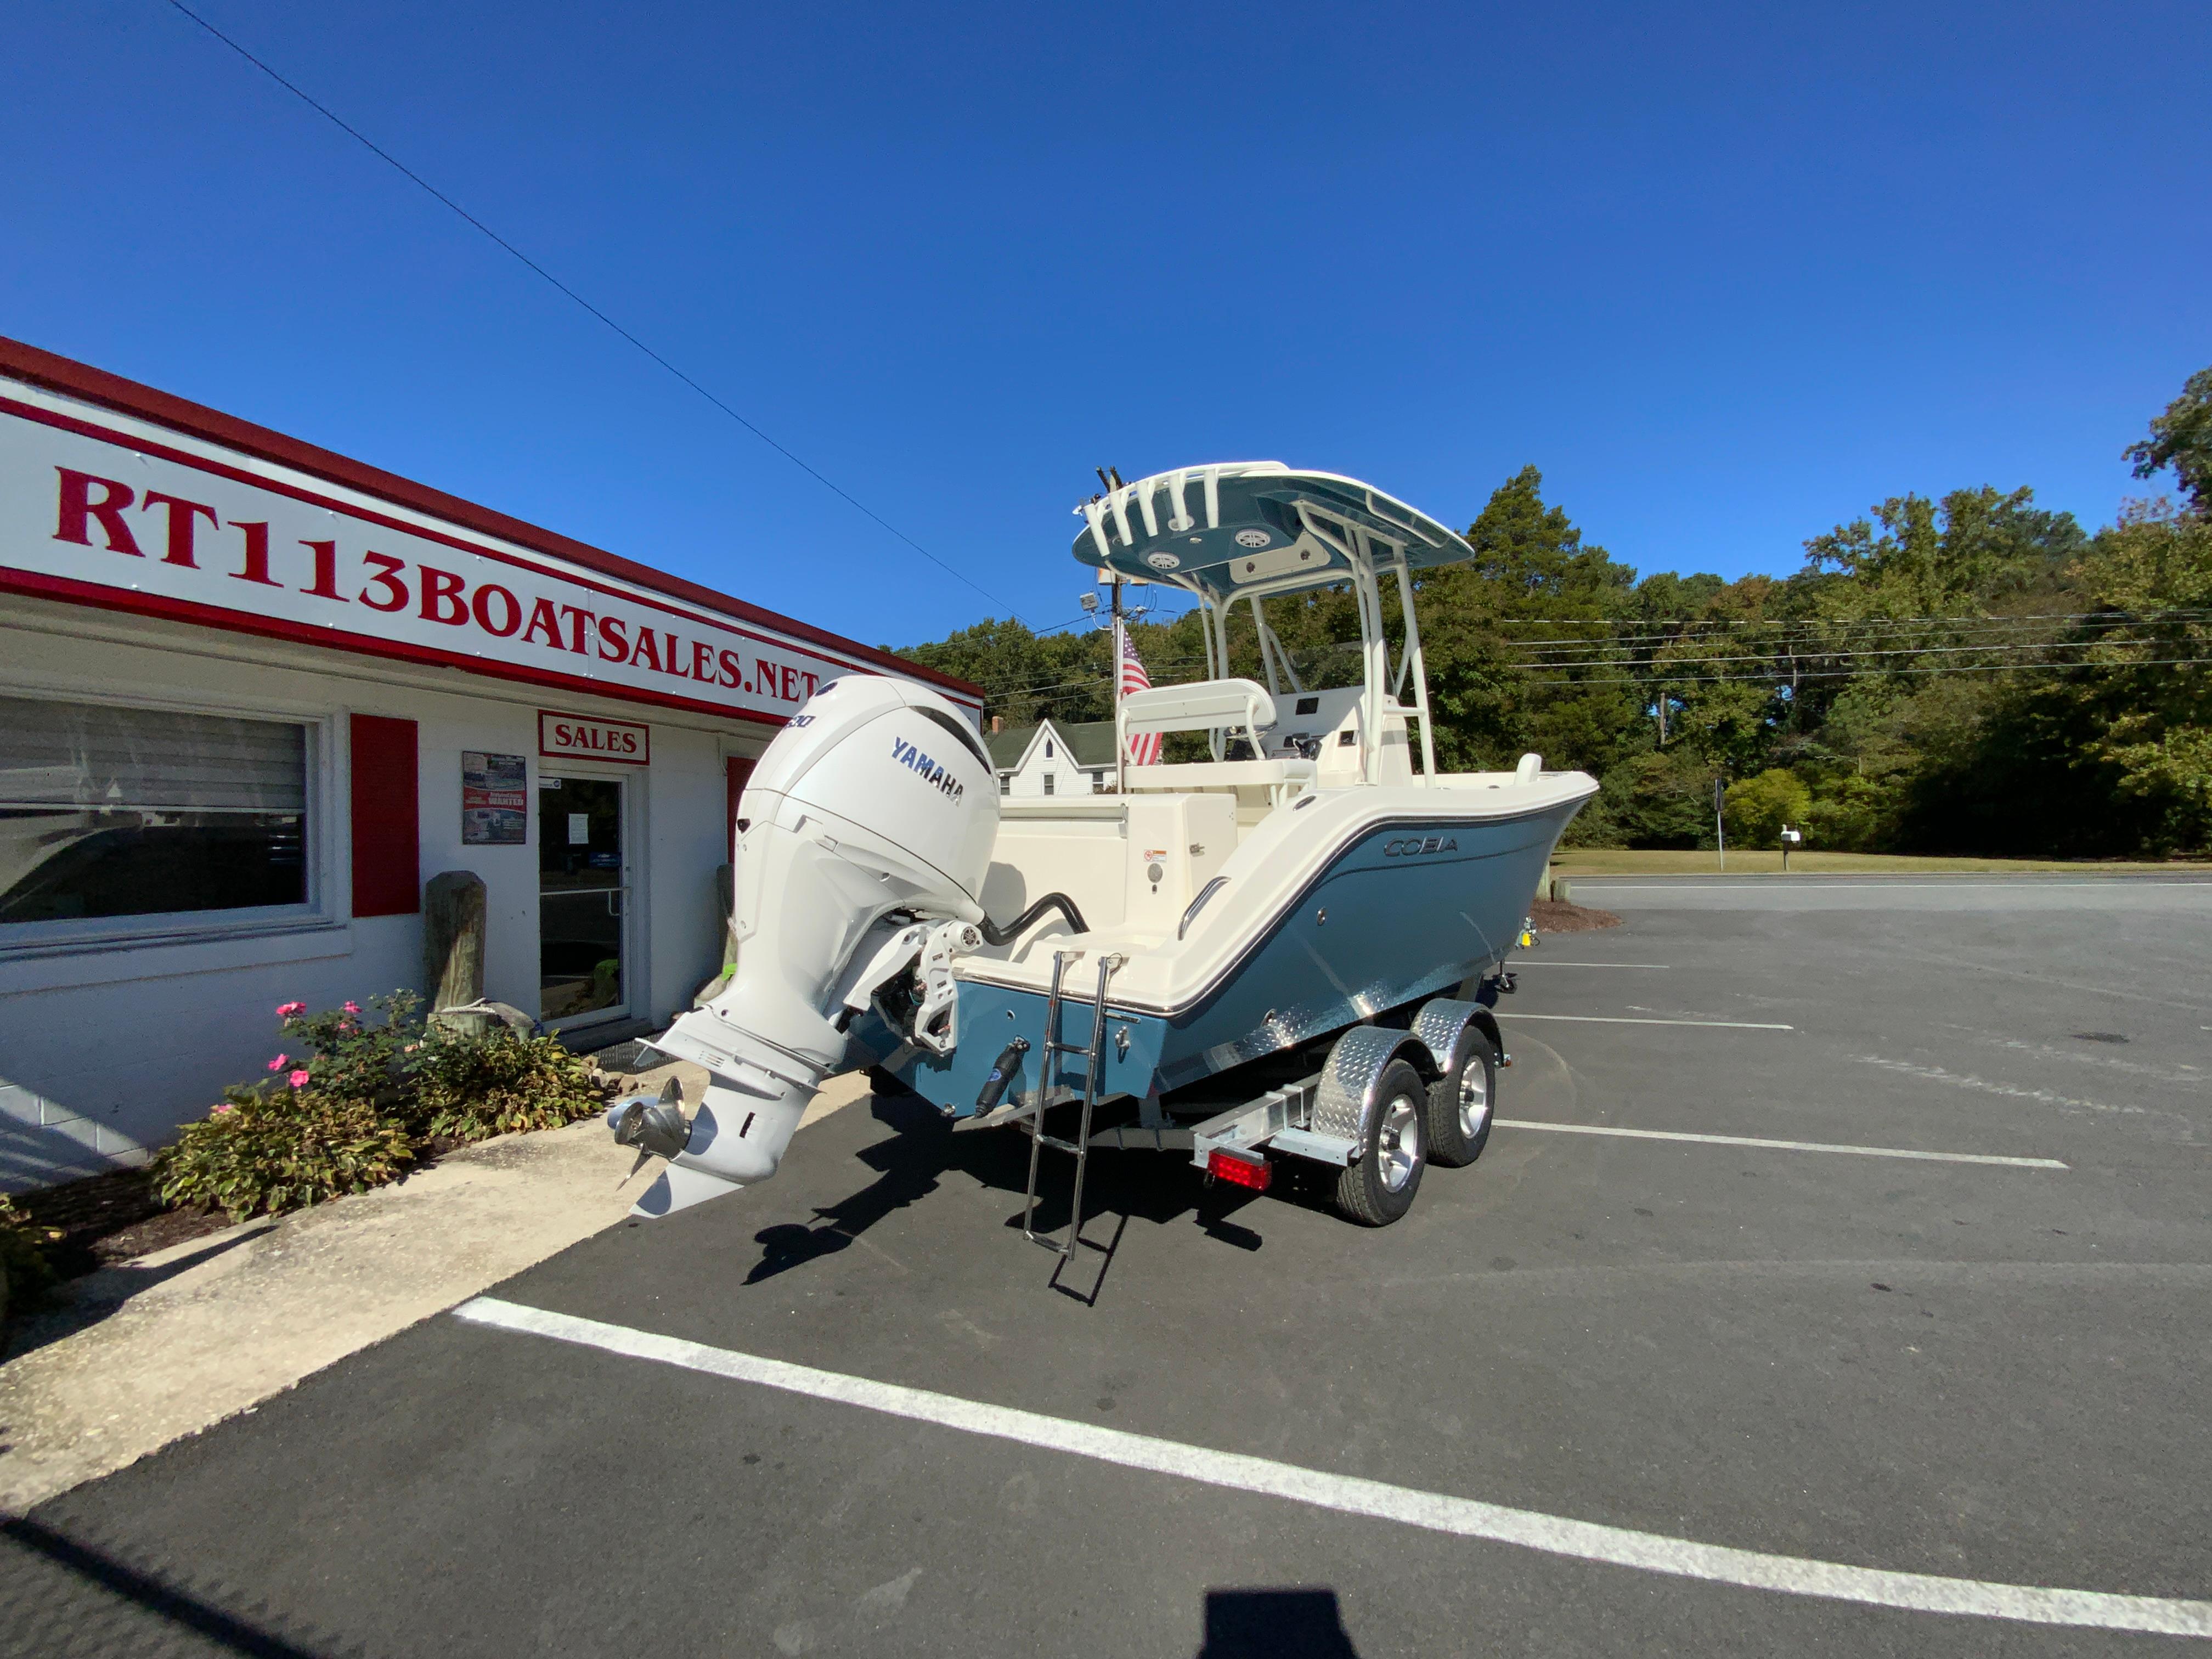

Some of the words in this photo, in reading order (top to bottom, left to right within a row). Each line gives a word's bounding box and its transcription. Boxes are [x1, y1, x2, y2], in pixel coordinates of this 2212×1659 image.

[53, 466, 820, 702] RT113BOATSALES.NET
[555, 724, 637, 753] SALES
[891, 736, 963, 807] YAMAHA
[1384, 837, 1458, 856] COBIA
